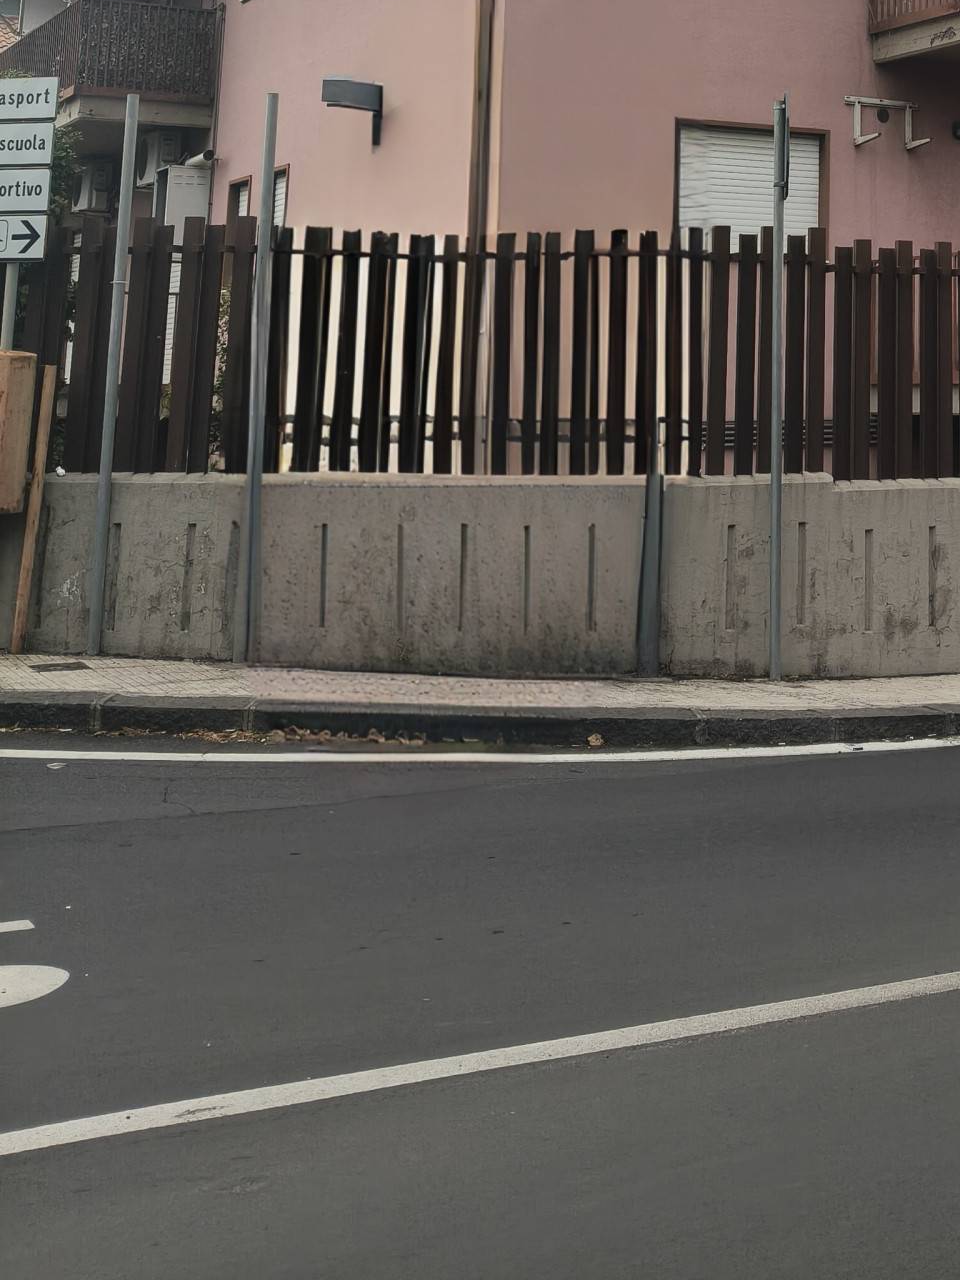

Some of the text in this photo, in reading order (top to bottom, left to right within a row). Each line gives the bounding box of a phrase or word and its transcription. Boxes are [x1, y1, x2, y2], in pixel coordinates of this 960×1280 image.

[0, 88, 50, 108] asport
[0, 134, 46, 151] scuola
[0, 181, 42, 197] ortivo
